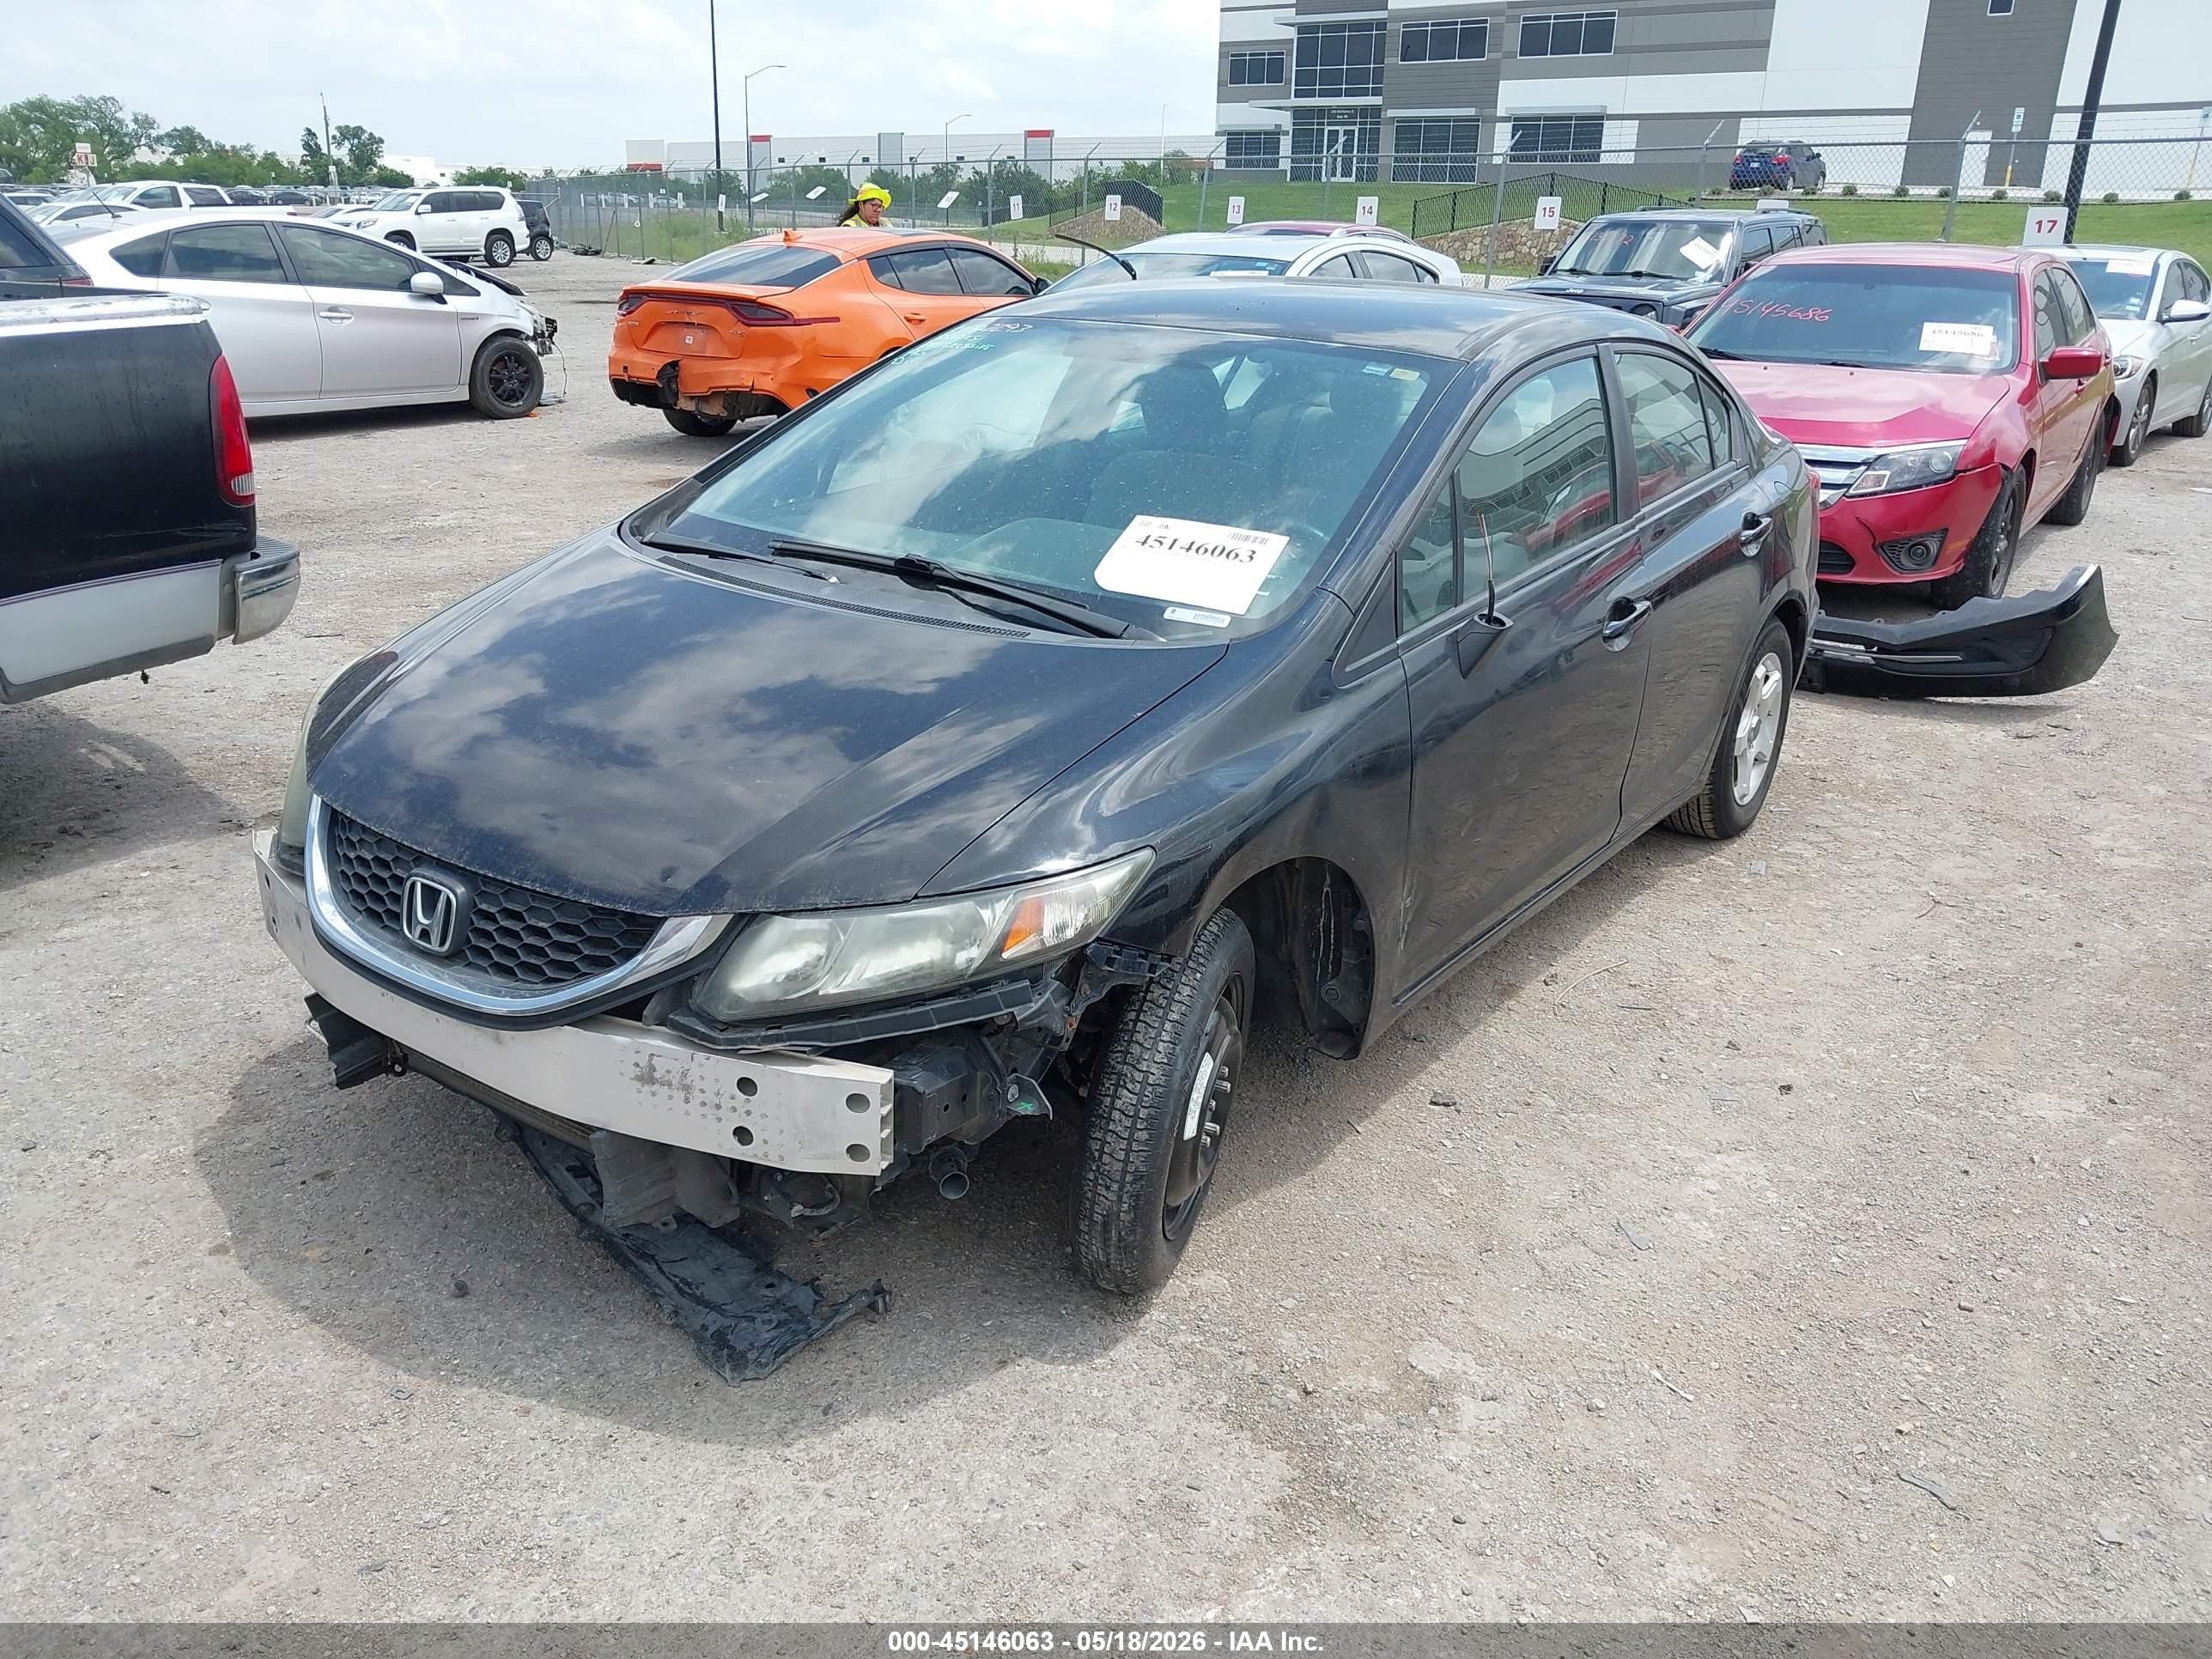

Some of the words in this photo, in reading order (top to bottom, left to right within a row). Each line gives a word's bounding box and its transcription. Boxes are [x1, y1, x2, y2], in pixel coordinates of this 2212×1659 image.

[1012, 203, 1020, 211] 11
[1109, 202, 1118, 212] 12
[1231, 204, 1241, 215] 13
[1361, 205, 1374, 216] 14
[1541, 206, 1556, 218] 15
[2035, 220, 2058, 234] 17
[1721, 299, 1832, 322] 45145686
[1134, 534, 1257, 563] 45146063
